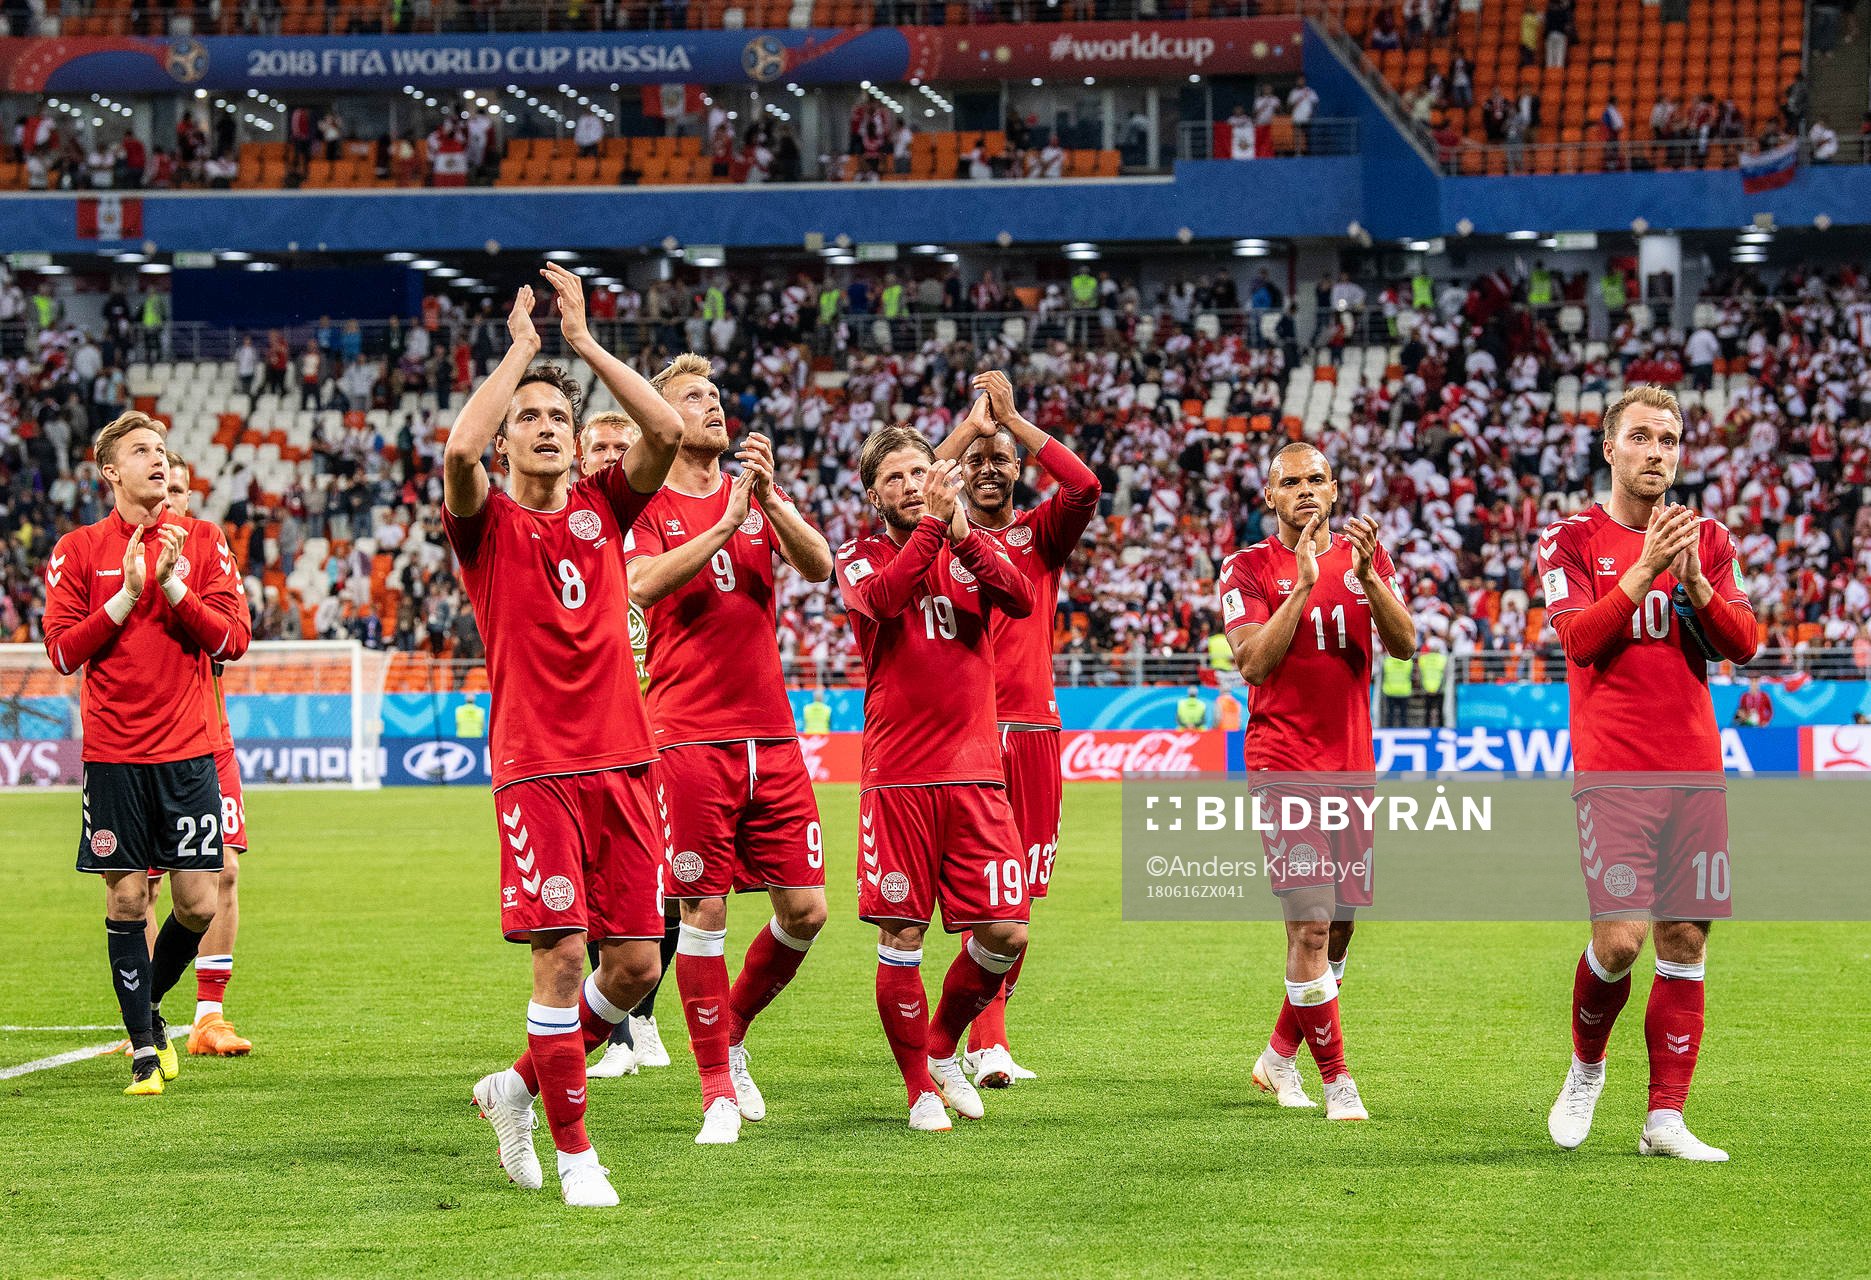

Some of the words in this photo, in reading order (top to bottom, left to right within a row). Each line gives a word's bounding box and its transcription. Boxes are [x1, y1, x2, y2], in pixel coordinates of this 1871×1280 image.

[248, 49, 317, 76] 2018
[322, 49, 387, 76] FIFA
[391, 47, 500, 75] WORLD
[505, 46, 570, 73] CUP
[576, 44, 692, 72] RUSSIA
[1050, 31, 1214, 66] #worldcup
[558, 558, 586, 610] 8
[711, 548, 736, 592] 9
[919, 595, 957, 640] 19
[1310, 604, 1347, 650] 11
[1631, 589, 1670, 639] 10
[0, 741, 60, 786] YS
[1061, 732, 1201, 781] Coca-Cola
[1372, 726, 1505, 782] 万达
[176, 813, 219, 857] 22
[807, 821, 823, 869] 9
[984, 859, 1023, 906] 19
[1028, 843, 1056, 885] 13
[1692, 851, 1731, 901] 10
